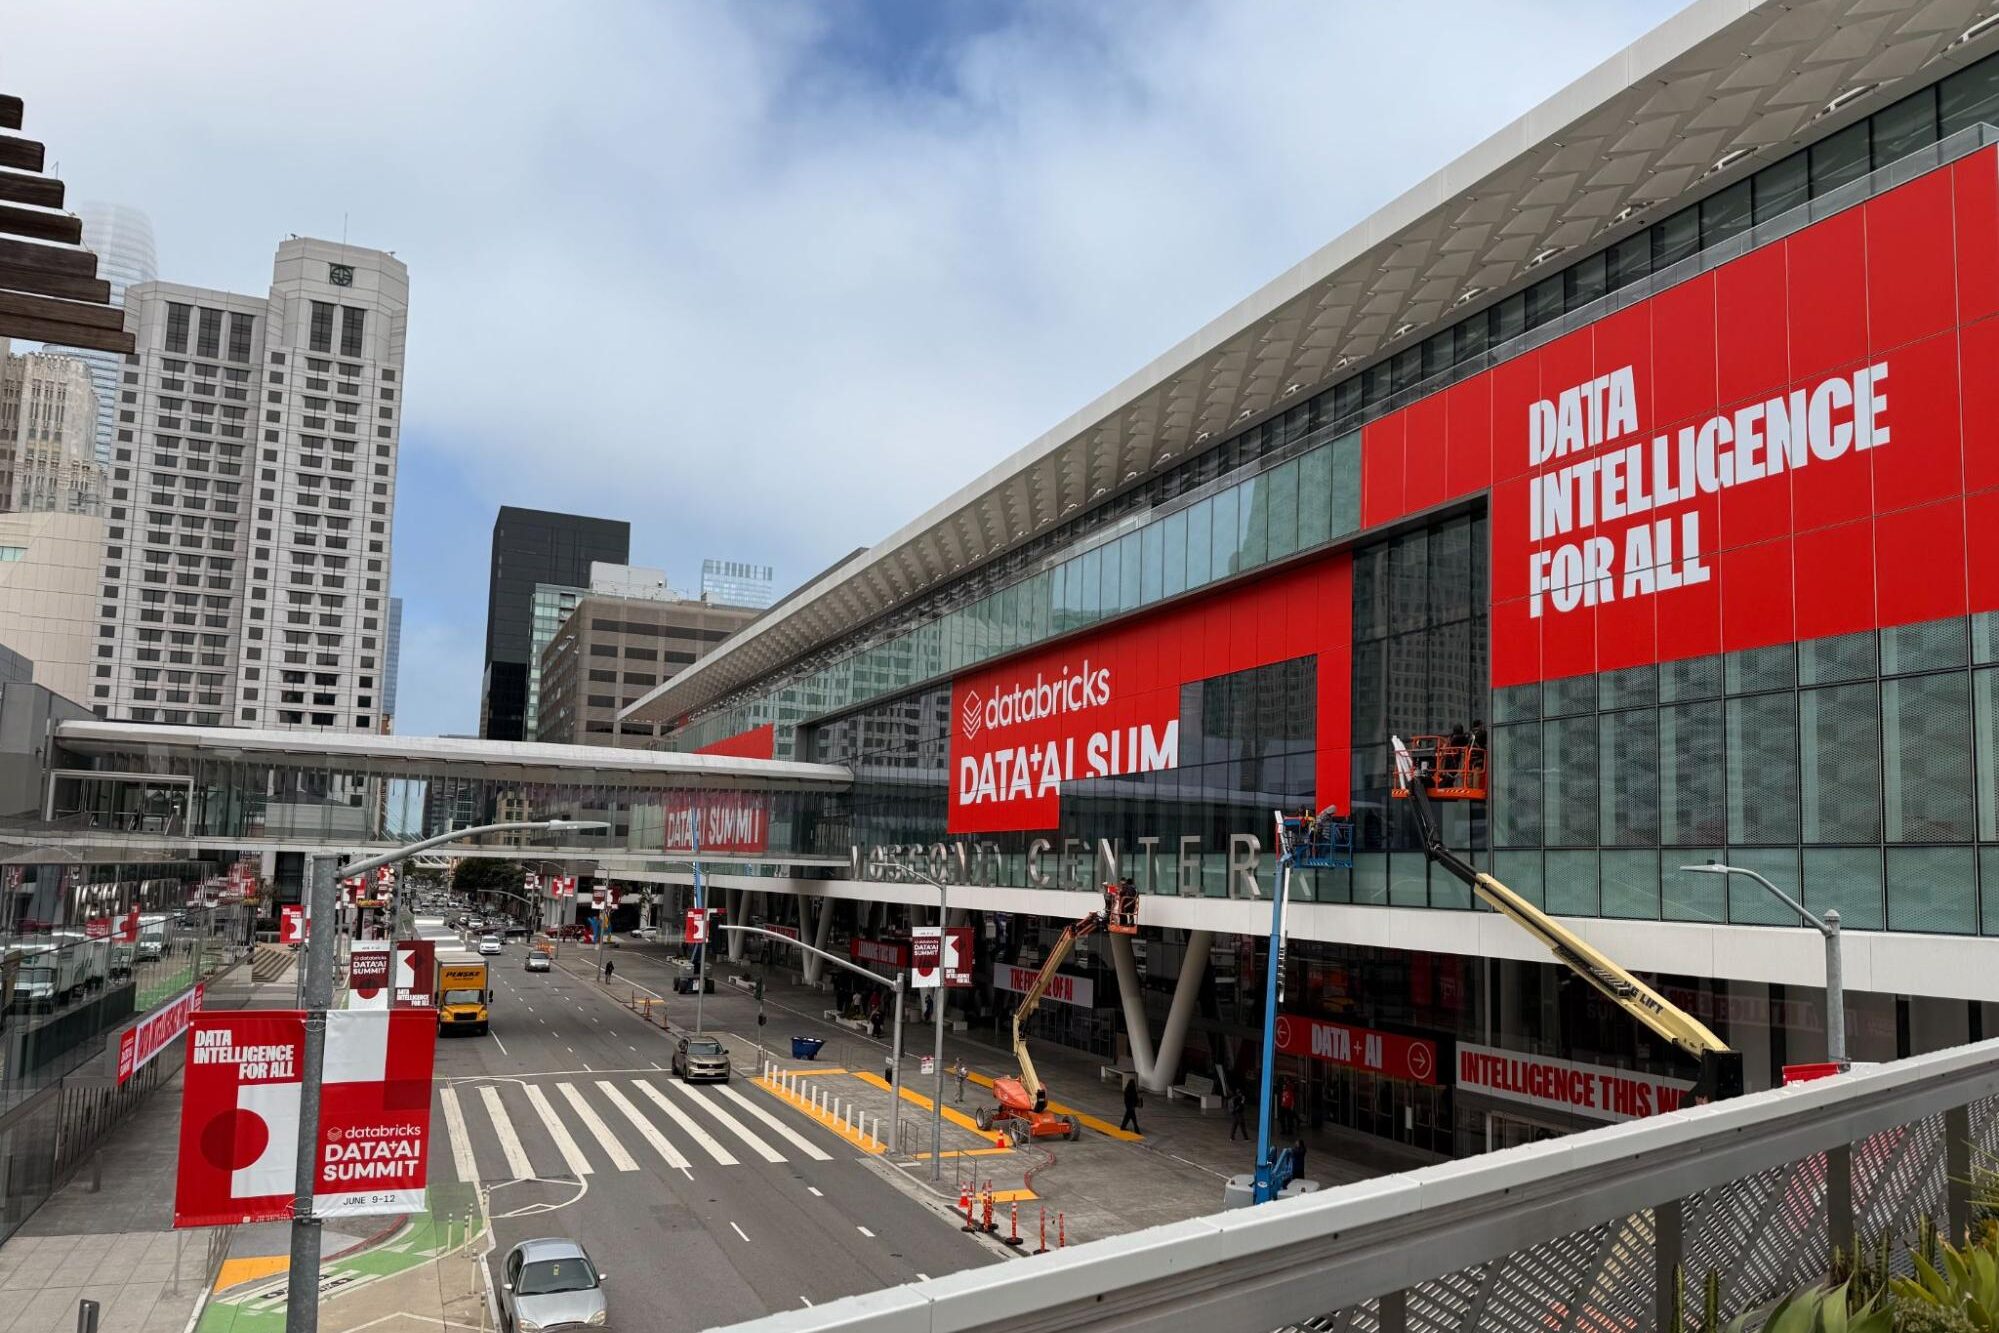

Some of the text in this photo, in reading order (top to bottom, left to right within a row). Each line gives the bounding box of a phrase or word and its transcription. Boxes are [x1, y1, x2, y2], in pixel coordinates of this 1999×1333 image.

[1529, 365, 1638, 467] DATA
[1529, 361, 1890, 541] INTELLIGENCE
[1529, 510, 1710, 619] FOR ALL
[985, 659, 1111, 730] databricks
[1028, 833, 1262, 900] CENTER
[353, 967, 386, 975] SUMMIT
[1639, 993, 1664, 1016] LIFT
[194, 1029, 232, 1048] DATA
[1311, 1023, 1351, 1061] DATA
[1365, 1034, 1383, 1069] AI
[193, 1045, 295, 1064] INTELLIGENCE
[239, 1060, 295, 1080] FOR ALL
[1460, 1050, 1596, 1109] INTELLIGENCE
[1600, 1075, 1652, 1118] THIS
[345, 1123, 421, 1139] databricks
[324, 1140, 421, 1163] DATA+AI
[323, 1160, 419, 1182] SUMMIT
[343, 1194, 396, 1206] JUNE 9-12
